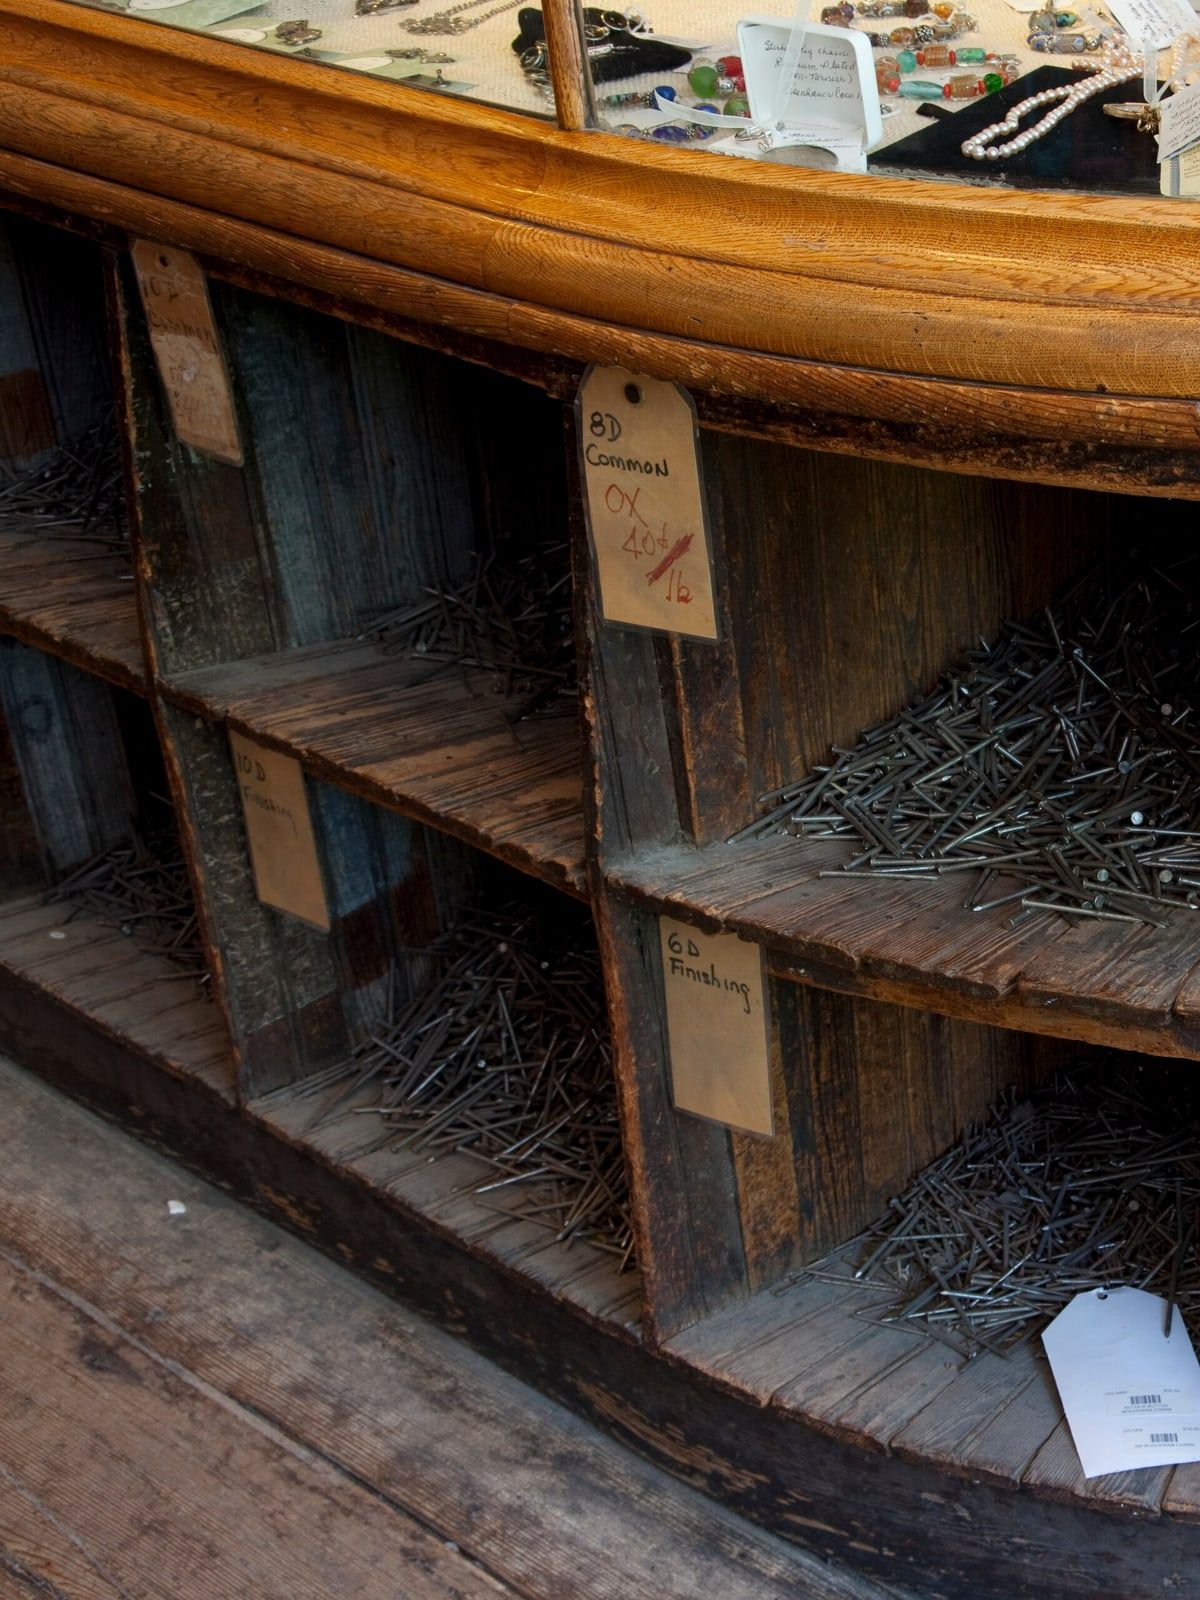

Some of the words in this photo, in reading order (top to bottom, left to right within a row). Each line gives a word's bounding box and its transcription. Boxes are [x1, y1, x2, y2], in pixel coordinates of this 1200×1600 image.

[589, 411, 622, 442] 8D
[585, 443, 669, 478] Common
[669, 956, 751, 1015] Finishing
